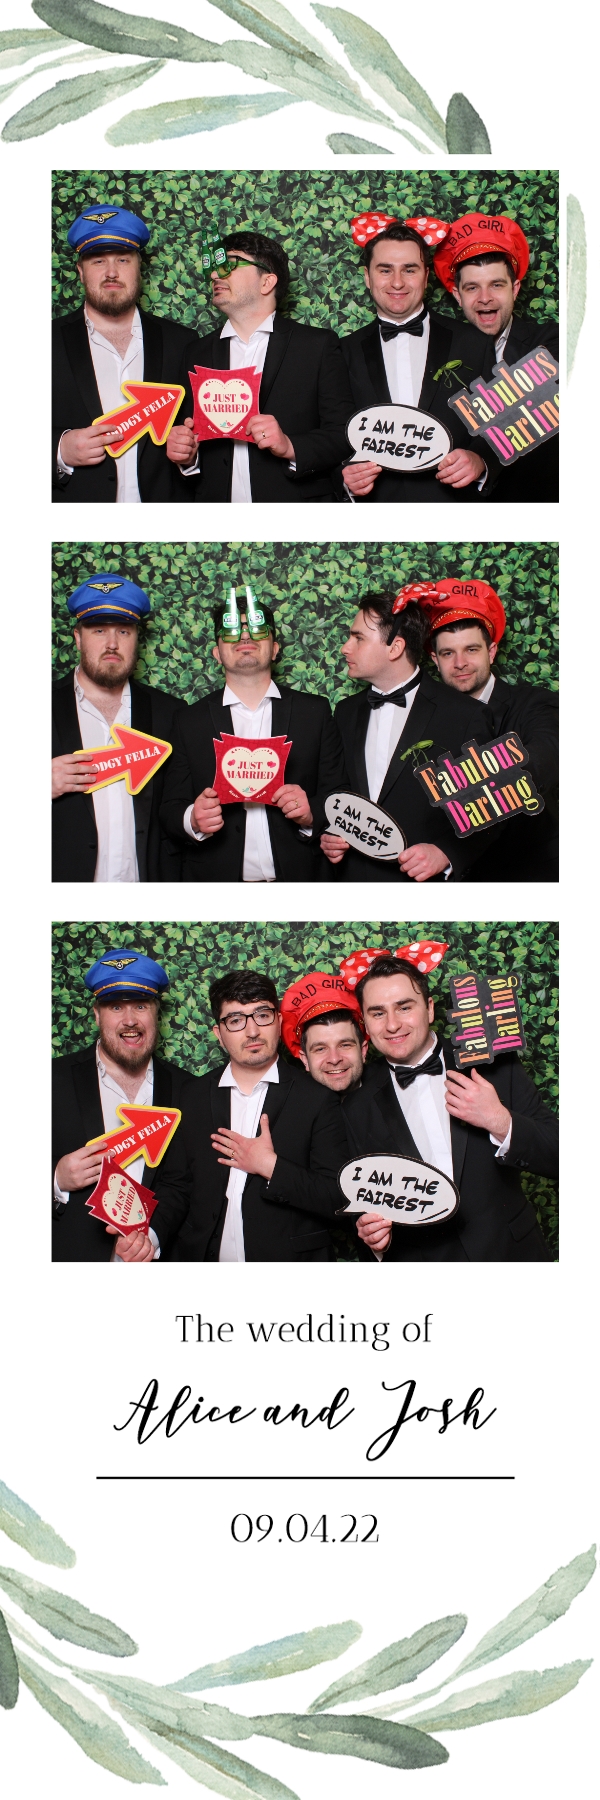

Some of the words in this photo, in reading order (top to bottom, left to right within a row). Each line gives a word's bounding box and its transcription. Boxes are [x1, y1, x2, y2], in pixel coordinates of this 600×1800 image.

[447, 224, 473, 246] BAD
[478, 219, 506, 236] GIRL
[142, 391, 176, 417] FELLA
[213, 393, 236, 403] JUST
[453, 351, 558, 432] Fabulous
[203, 404, 249, 413] MARRIED
[358, 417, 368, 431] I
[372, 419, 394, 434] AM
[402, 424, 435, 441] THE
[484, 393, 559, 460] Darlin
[361, 437, 431, 460] FAIREST
[452, 585, 479, 598] GIRL
[125, 745, 161, 764] FELLA
[238, 761, 263, 770] JUST
[227, 771, 274, 780] MARRIED
[419, 737, 524, 803] Fabulous
[445, 776, 539, 833] Darling
[333, 799, 341, 810] I
[343, 805, 361, 821] AM
[366, 817, 393, 838] THE
[335, 816, 388, 850] FAIREST
[291, 984, 317, 1007] BAD
[451, 976, 490, 1063] Fabulous
[487, 976, 522, 1051] Darling
[137, 1115, 172, 1140] FELLA
[352, 1167, 362, 1181] I
[367, 1170, 393, 1186] AM
[401, 1176, 440, 1195] THE
[115, 1188, 126, 1211] JUST
[120, 1186, 136, 1224] MARRIED
[356, 1188, 434, 1214] FAIREST
